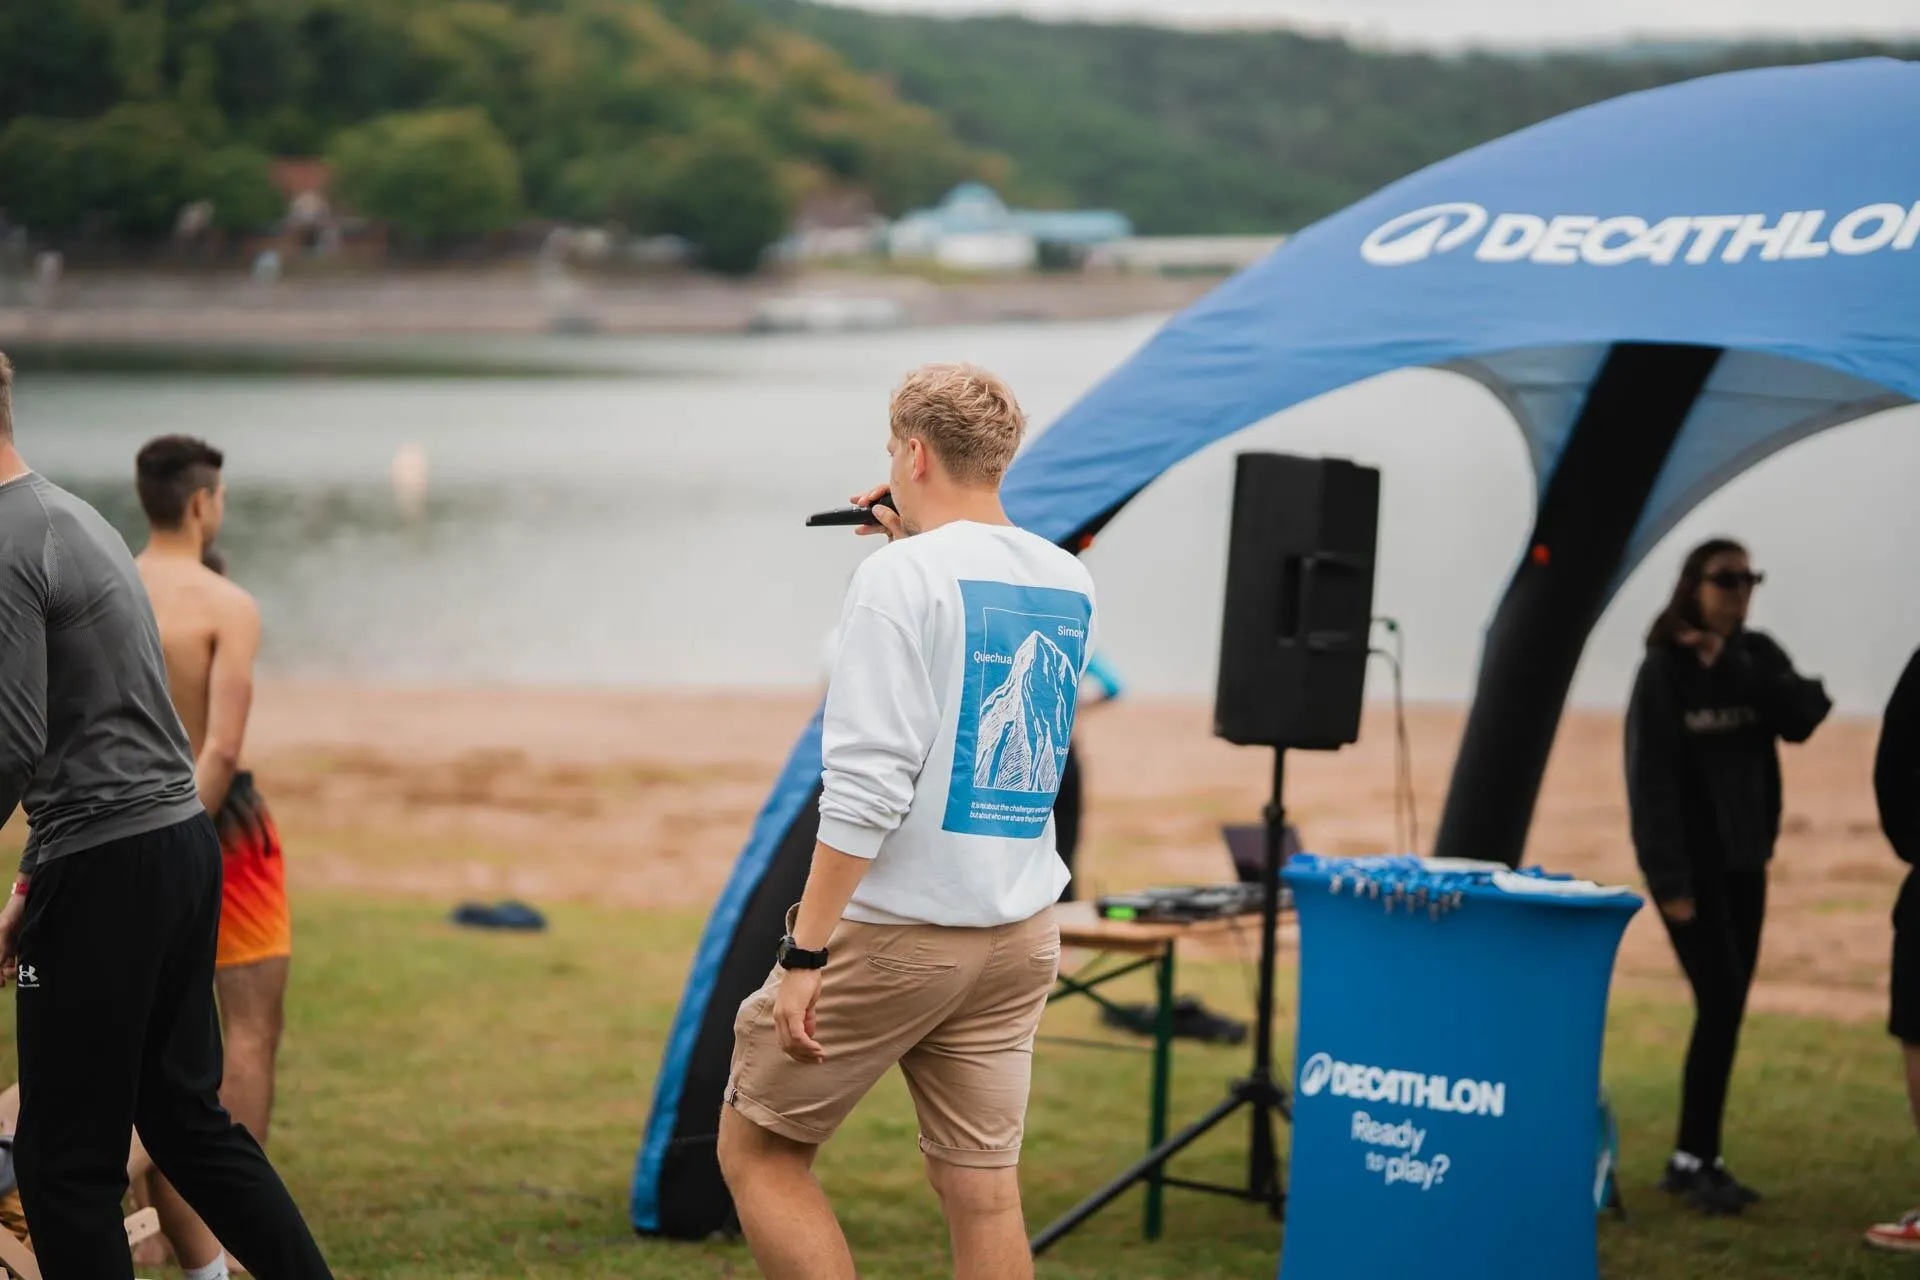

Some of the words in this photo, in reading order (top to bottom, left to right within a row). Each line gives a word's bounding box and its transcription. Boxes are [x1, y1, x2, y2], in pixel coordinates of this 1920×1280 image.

[973, 650, 1013, 665] Quechua
[1330, 1060, 1506, 1117] DECATHLON
[1351, 1110, 1426, 1155] Ready
[1365, 1151, 1386, 1171] to
[1385, 1151, 1450, 1191] play?
